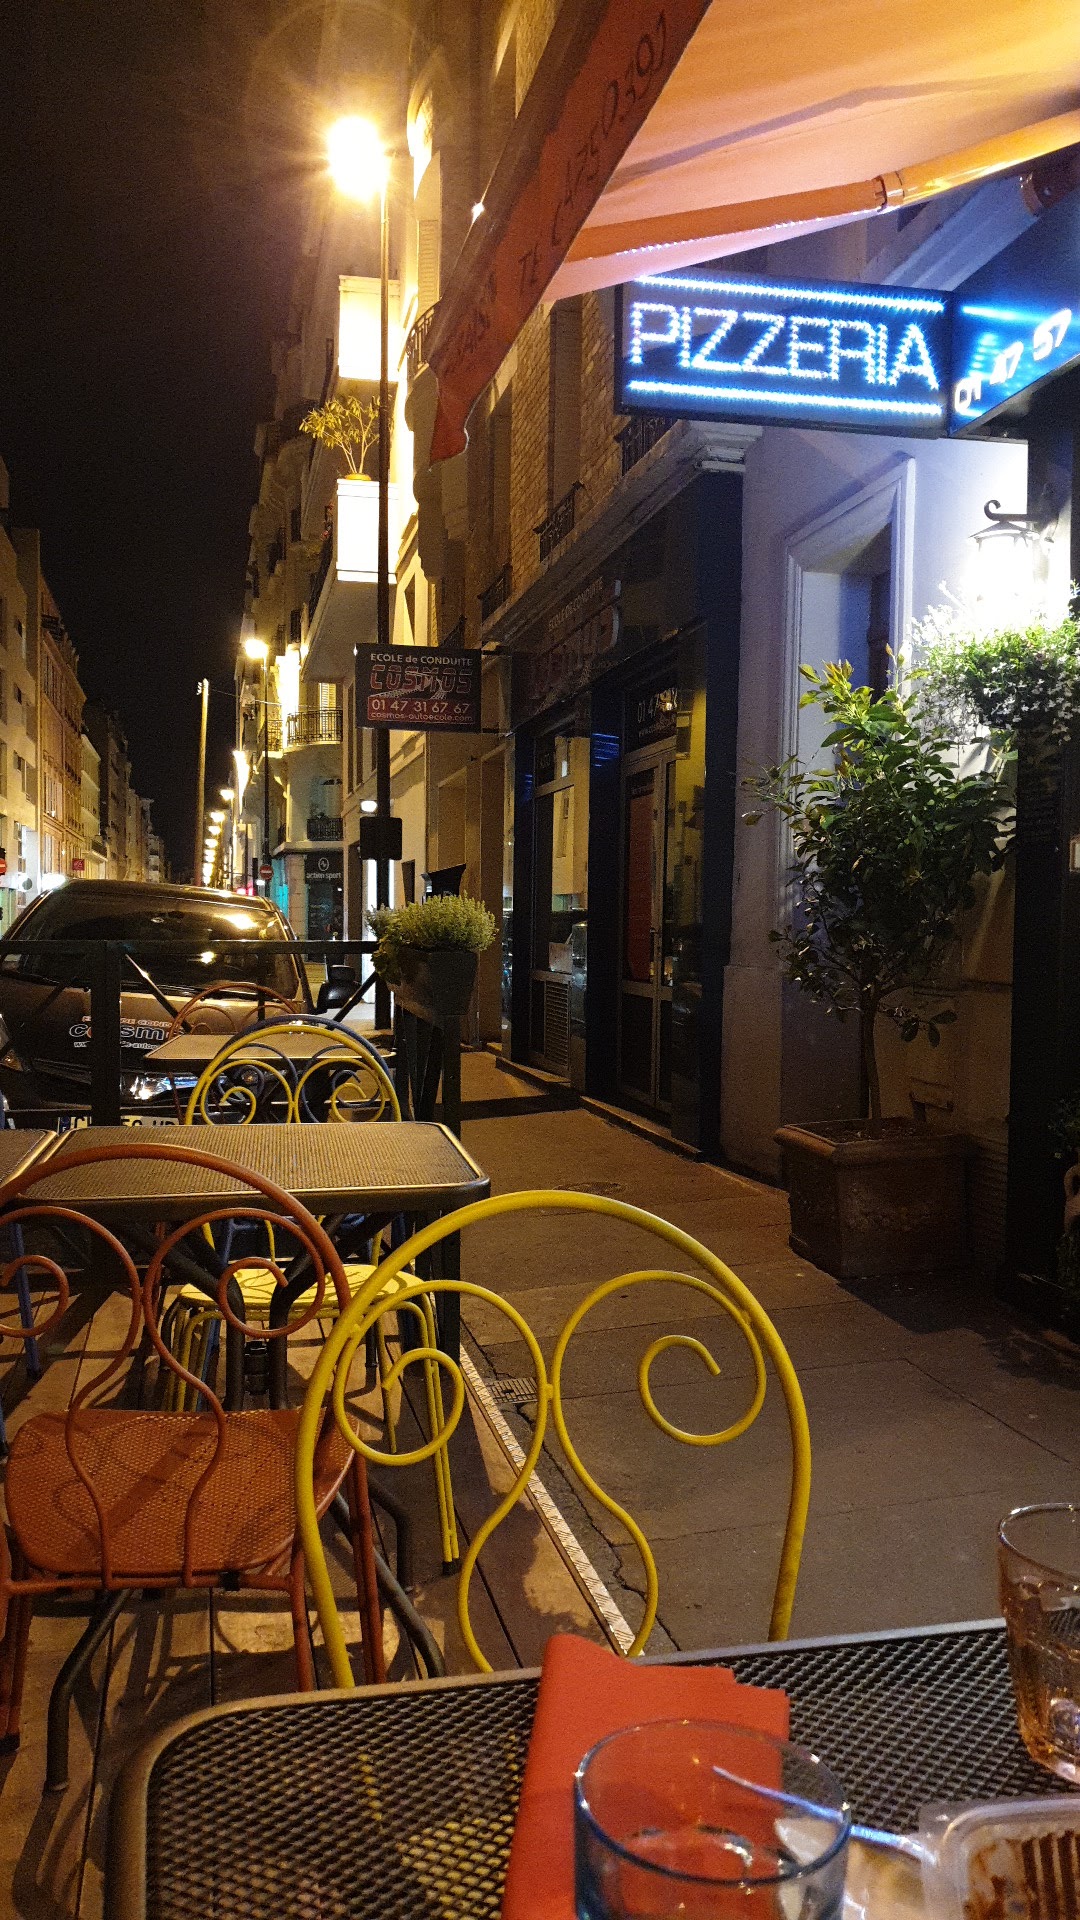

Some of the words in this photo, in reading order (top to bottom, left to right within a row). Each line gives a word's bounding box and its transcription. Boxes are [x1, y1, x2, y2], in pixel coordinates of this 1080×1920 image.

[629, 301, 940, 391] PIZZERIA
[954, 374, 982, 412] 01
[1033, 308, 1072, 360] 57
[370, 653, 403, 663] ECOLE
[405, 655, 418, 663] de
[420, 656, 473, 667] CONDUITE
[370, 664, 473, 694] COSMOS
[371, 699, 385, 710] 01
[390, 700, 408, 711] 47
[414, 701, 427, 712] 31
[432, 702, 448, 713] 67
[453, 703, 470, 714] 67
[370, 711, 473, 721] cosmos-autoecole.com
[325, 872, 341, 880] sport
